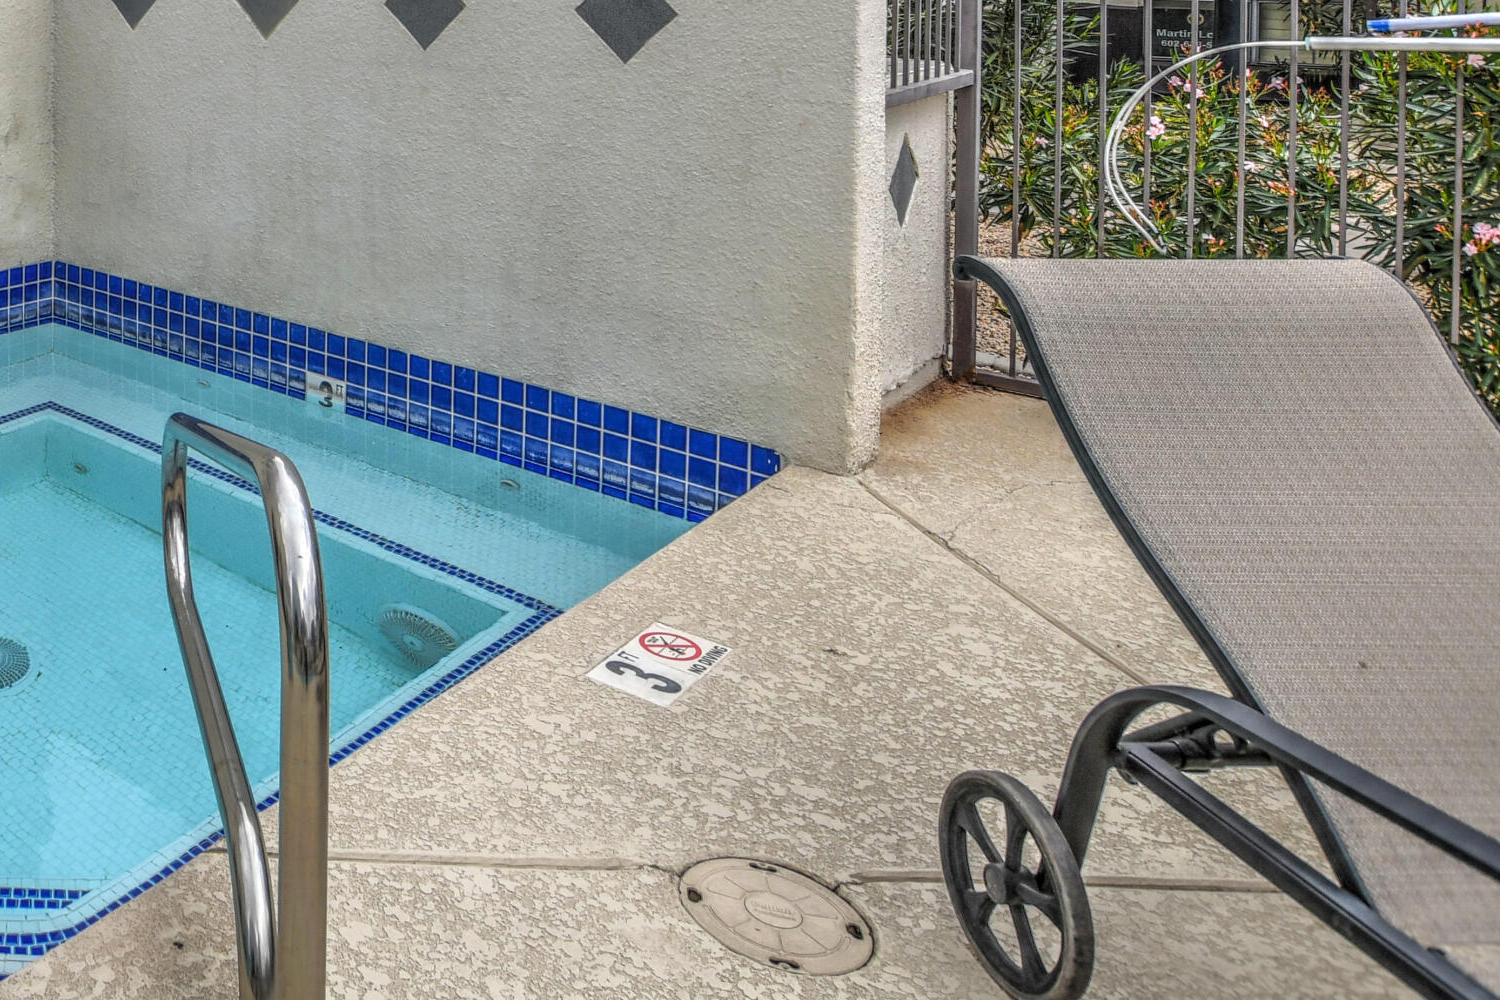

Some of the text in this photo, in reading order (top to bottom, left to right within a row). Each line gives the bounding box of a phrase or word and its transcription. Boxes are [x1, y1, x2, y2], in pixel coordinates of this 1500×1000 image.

[318, 381, 344, 407] 3 FT
[605, 650, 682, 693] 3 FT
[687, 645, 728, 675] NO DIVING
